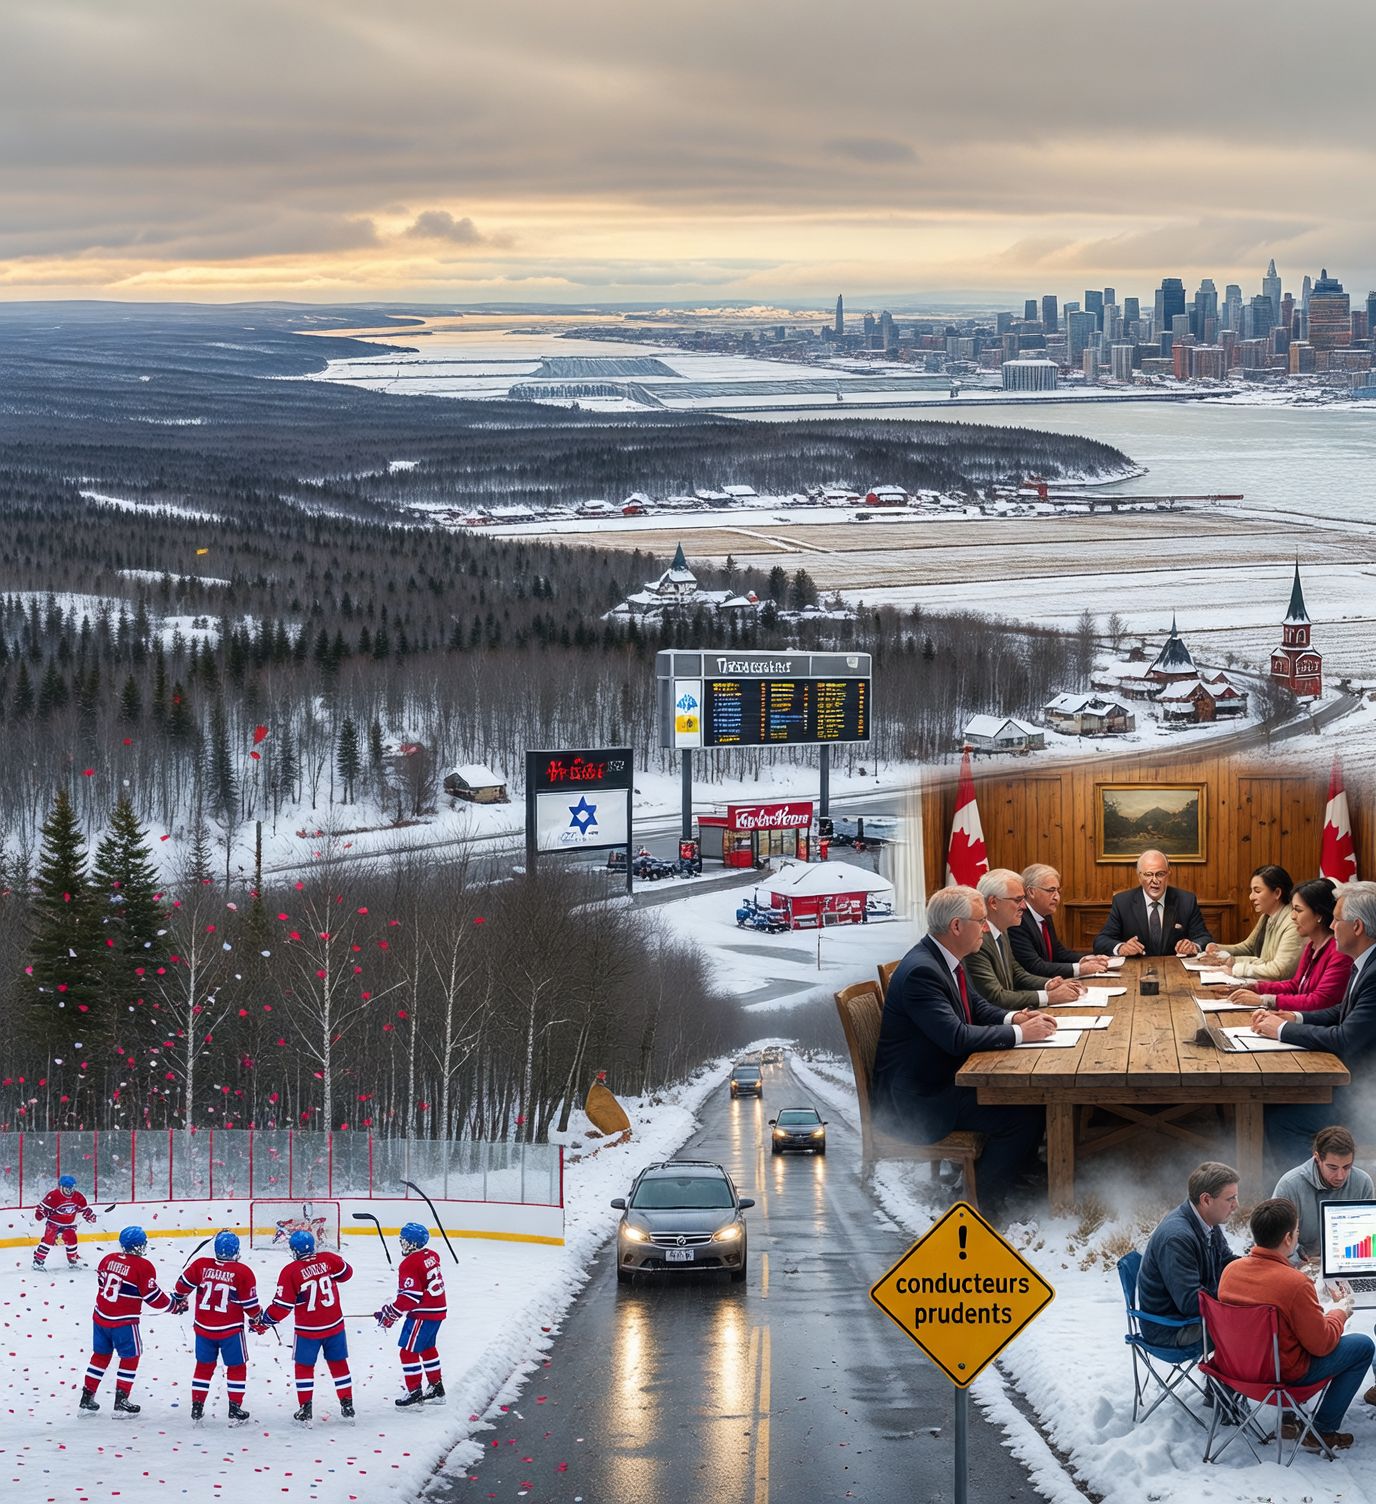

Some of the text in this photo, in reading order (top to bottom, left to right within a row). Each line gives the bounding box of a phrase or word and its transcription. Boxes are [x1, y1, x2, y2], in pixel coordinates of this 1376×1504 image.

[300, 1275, 335, 1312] 79
[896, 1272, 1030, 1294] conducteurs
[915, 1301, 1012, 1330] prudents
